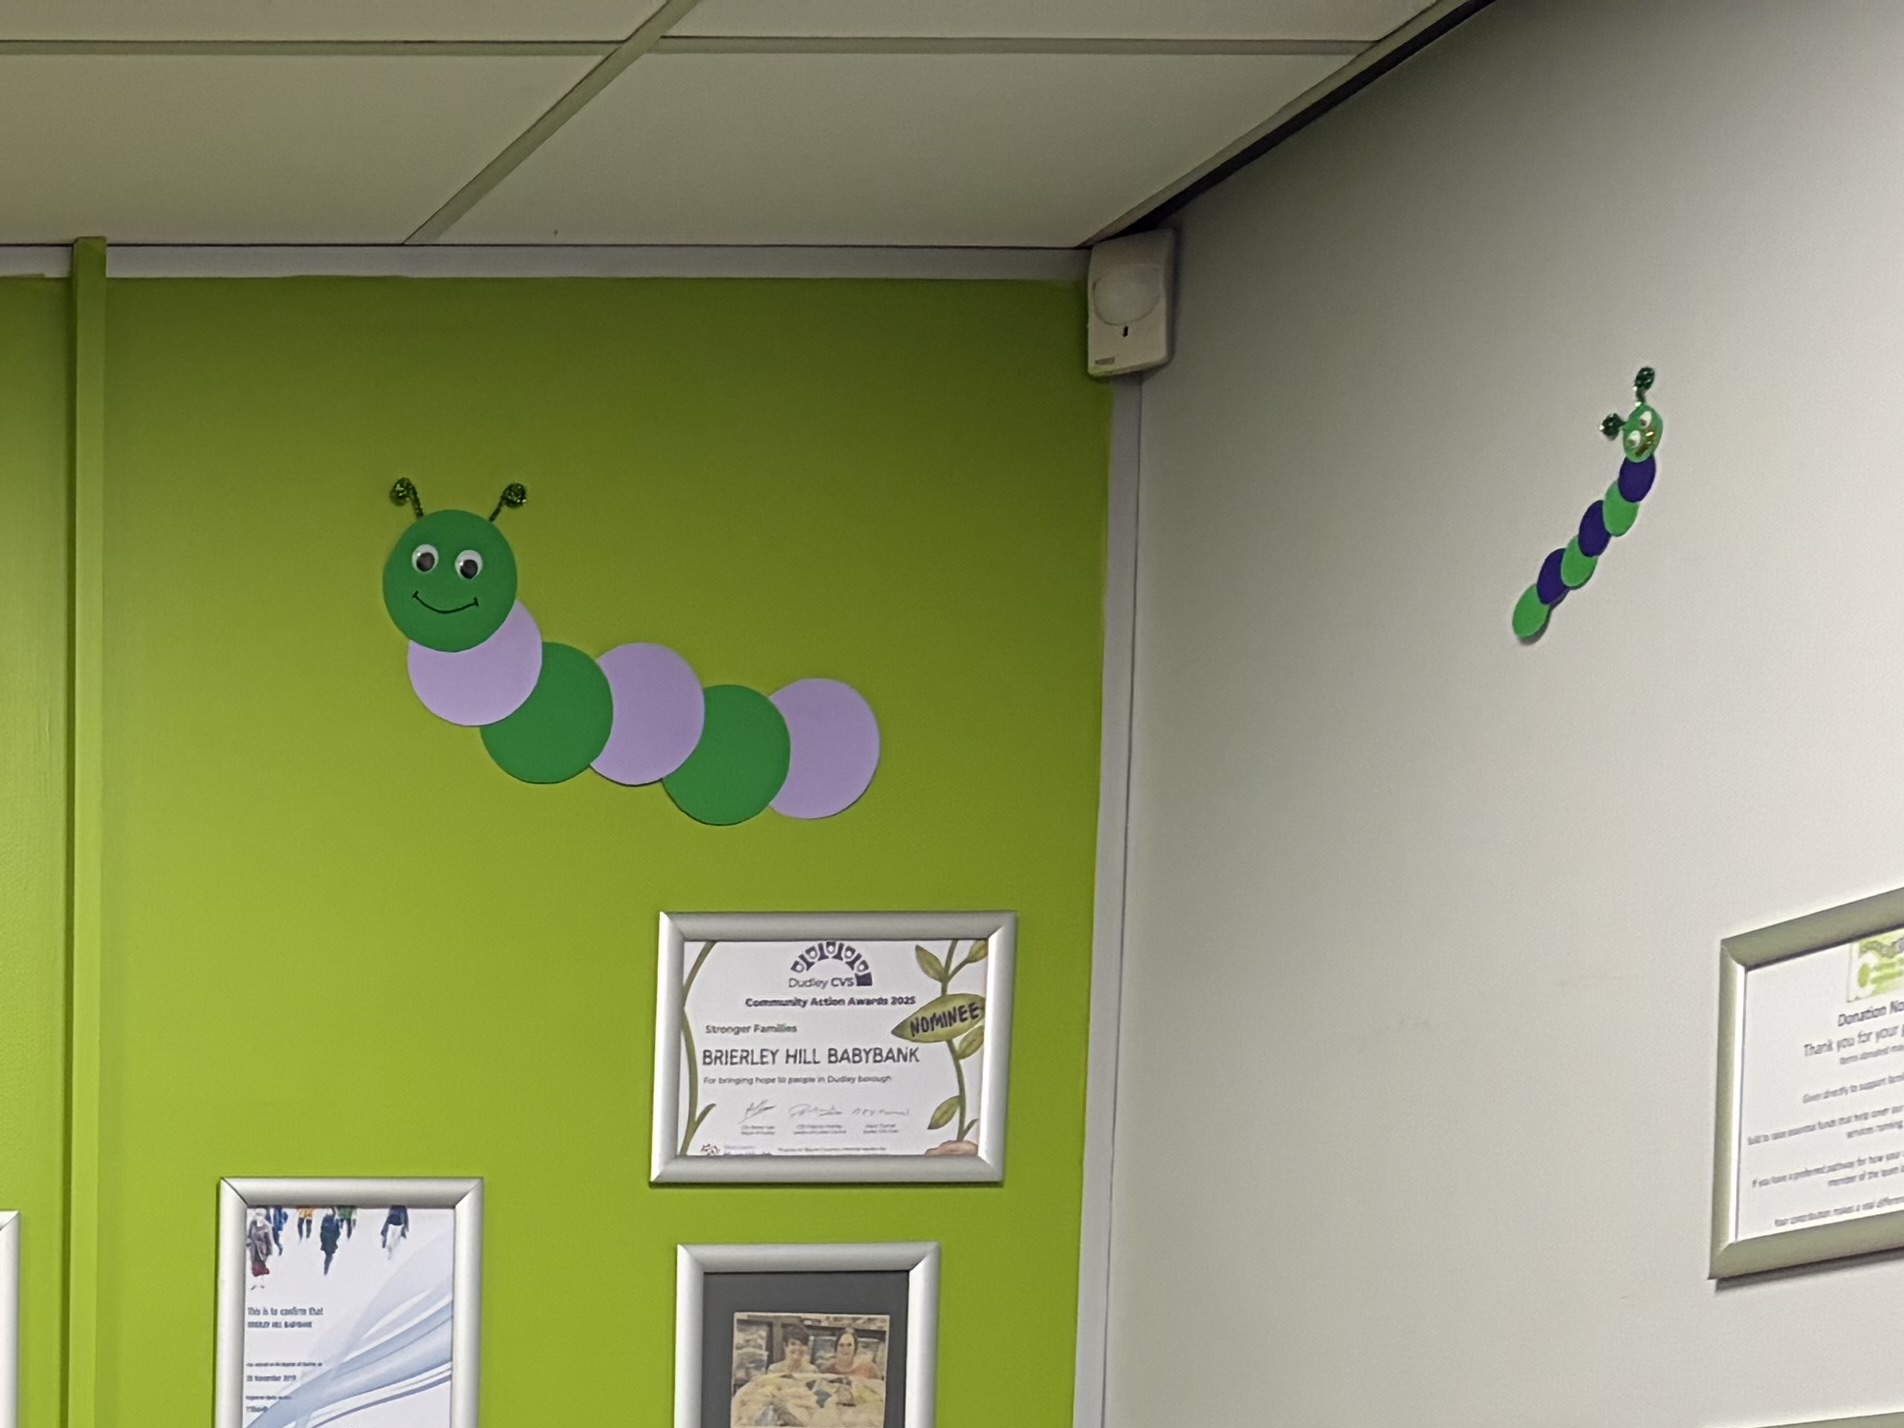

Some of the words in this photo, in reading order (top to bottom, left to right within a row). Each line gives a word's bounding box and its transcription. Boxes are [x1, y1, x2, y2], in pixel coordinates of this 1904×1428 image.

[745, 996, 807, 1008] Community
[810, 996, 846, 1007] Action
[848, 996, 888, 1007] Awards
[910, 1002, 980, 1037] NOMINEE
[705, 1024, 751, 1035] Stronger
[753, 1024, 797, 1034] Families
[702, 1048, 778, 1066] BRIERLEY
[786, 1048, 821, 1065] HILL
[827, 1047, 920, 1064] BABYBANK
